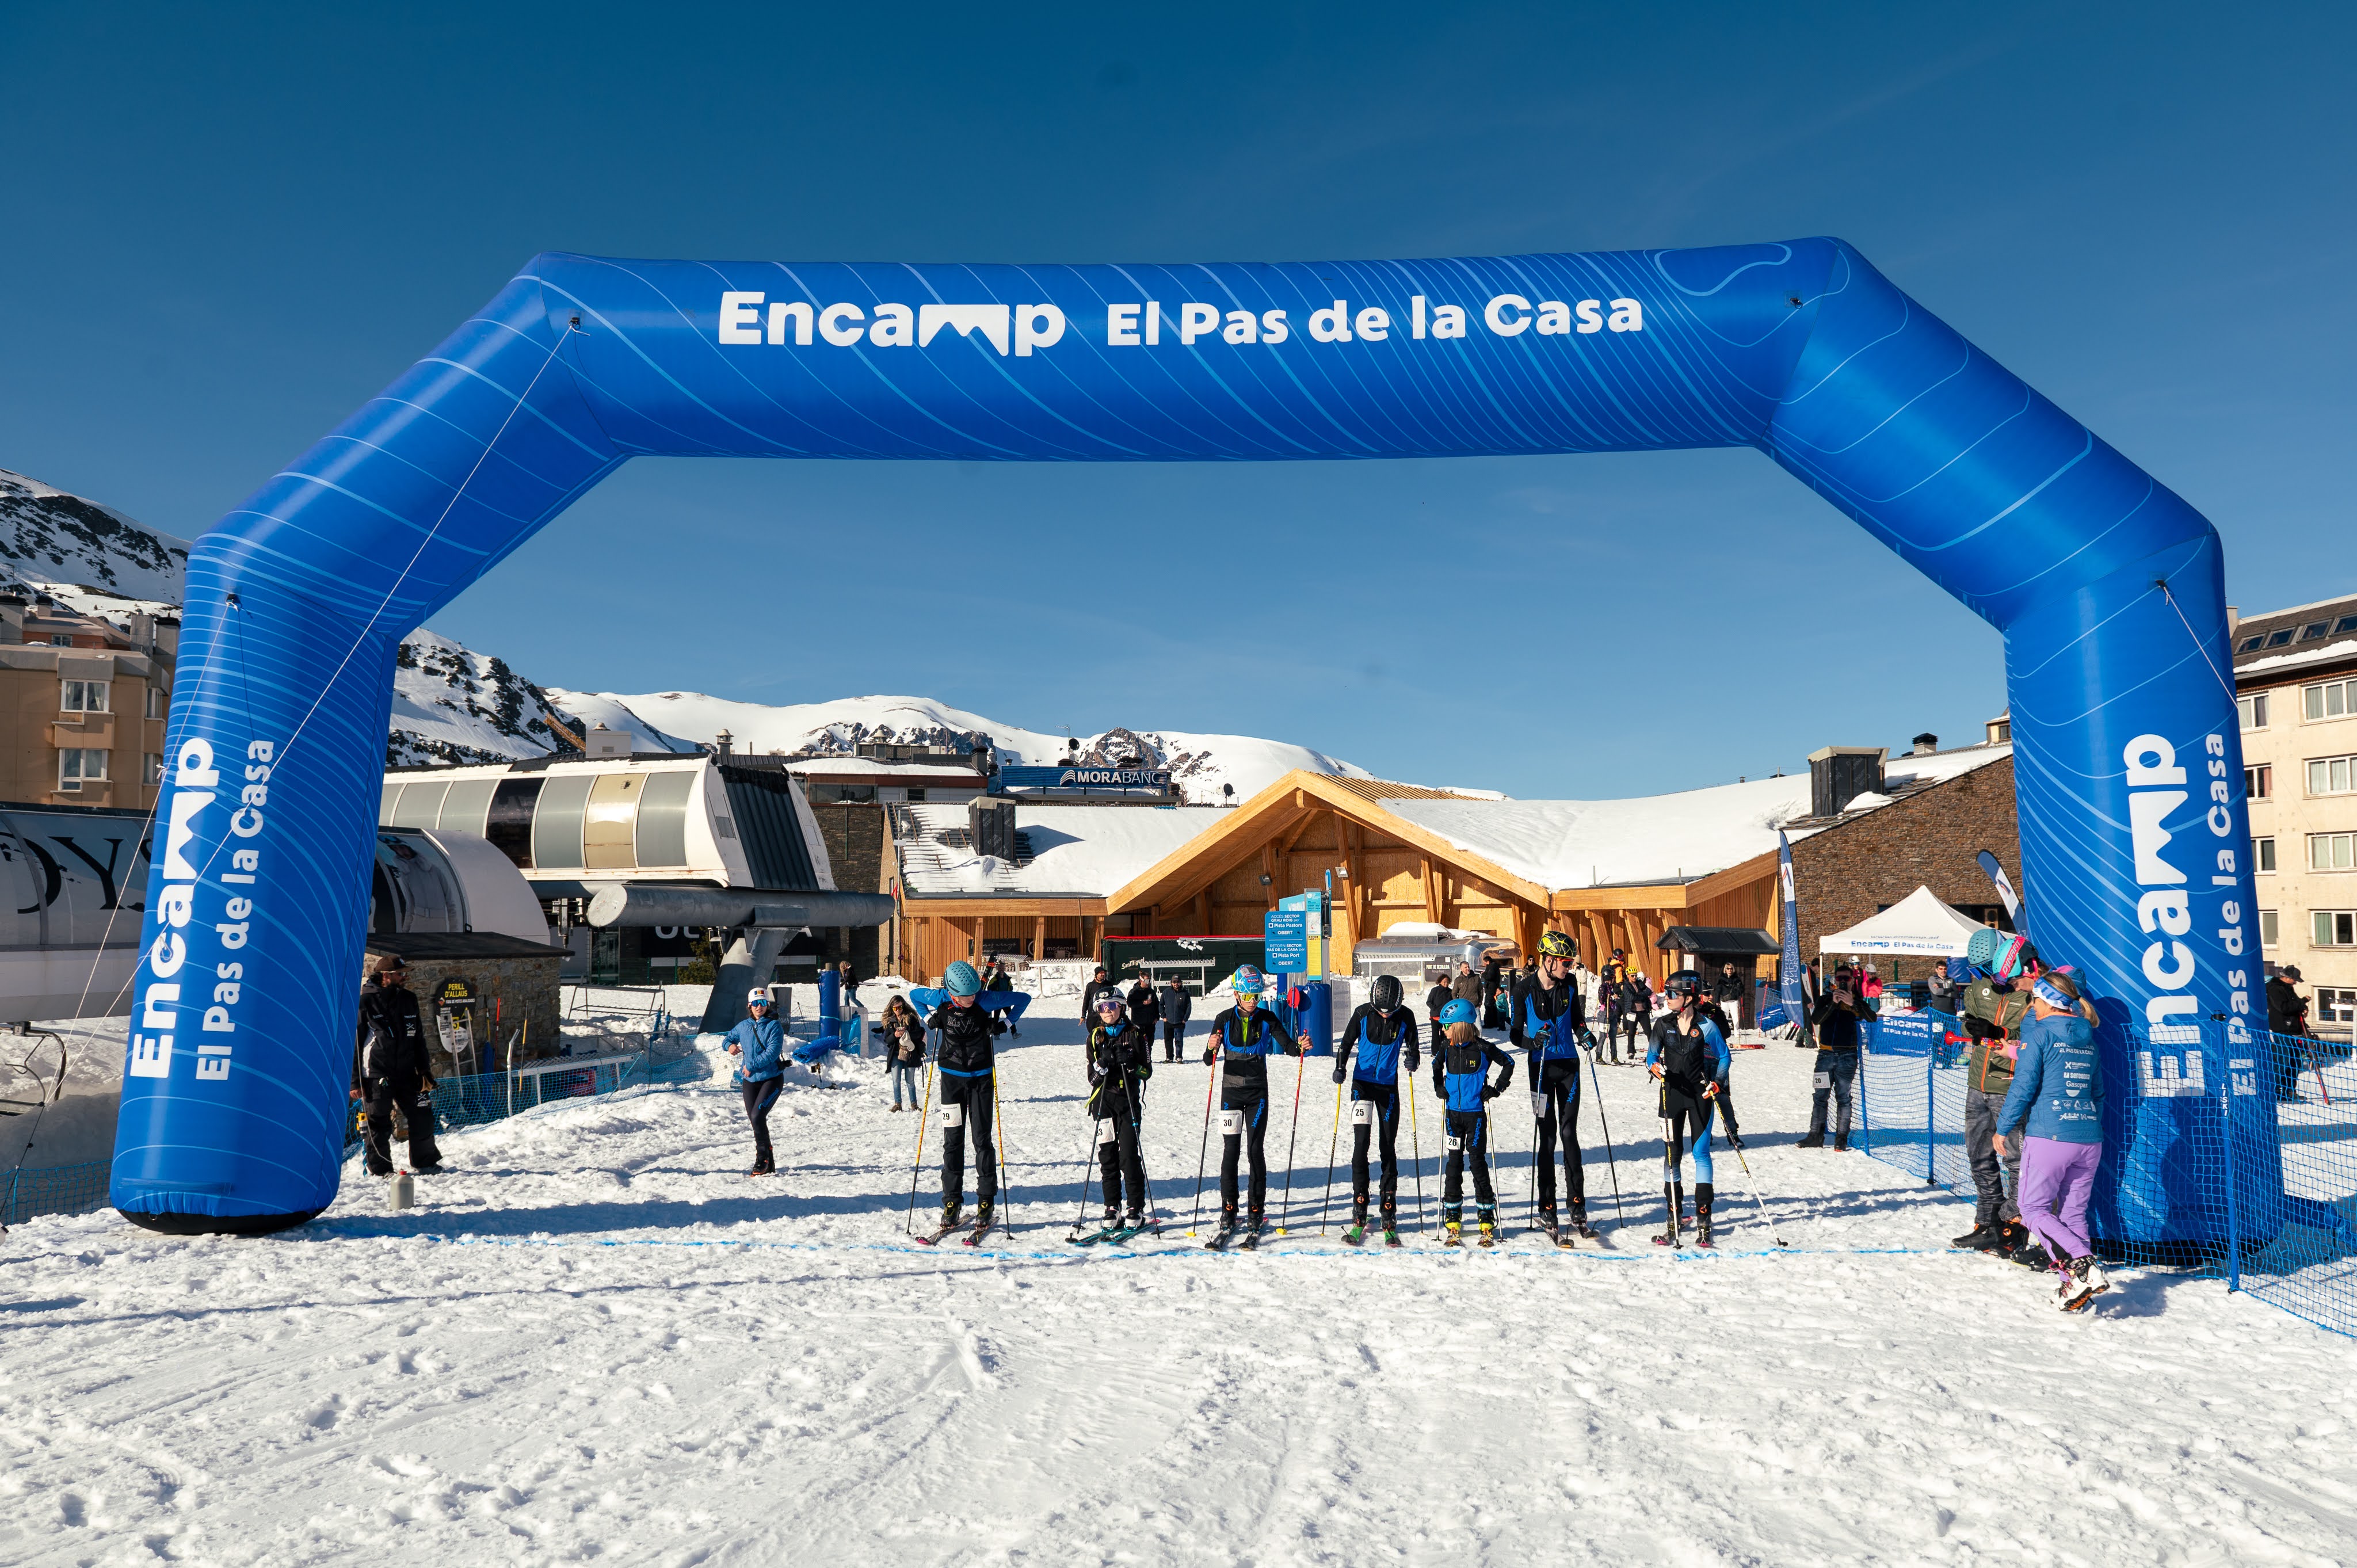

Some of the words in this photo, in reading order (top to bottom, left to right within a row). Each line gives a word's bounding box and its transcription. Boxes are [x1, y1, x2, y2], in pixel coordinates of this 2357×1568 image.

[719, 292, 1066, 357] Encamp
[1108, 302, 1160, 346] El
[1181, 303, 1288, 345] Pas
[1309, 300, 1390, 342] de
[1412, 296, 1466, 339] la
[1485, 293, 1642, 337] Casa
[231, 740, 274, 838] Casa
[1077, 770, 1160, 784] MORABANC
[2206, 734, 2232, 838] Casa
[221, 849, 259, 884] la
[2212, 850, 2237, 886] la
[130, 738, 220, 1078] Encamp
[216, 897, 252, 949] de
[2123, 734, 2205, 1097] Encamp
[2217, 901, 2243, 956] de
[2002, 940, 2021, 975] DYNAFIT
[203, 962, 243, 1032] Pas
[2228, 970, 2252, 1044] Pas
[196, 1045, 232, 1080] El
[2229, 1059, 2257, 1096] El
[1566, 1071, 1579, 1103] KARPOS
[2066, 1081, 2088, 1089] Gasopas
[943, 1112, 950, 1120] 29
[1251, 1098, 1265, 1128] KARPOS
[1355, 1108, 1364, 1116] 25
[1383, 1093, 1395, 1123] KARPOS
[1448, 1138, 1457, 1146] 26
[1471, 1117, 1482, 1147] KARPOS
